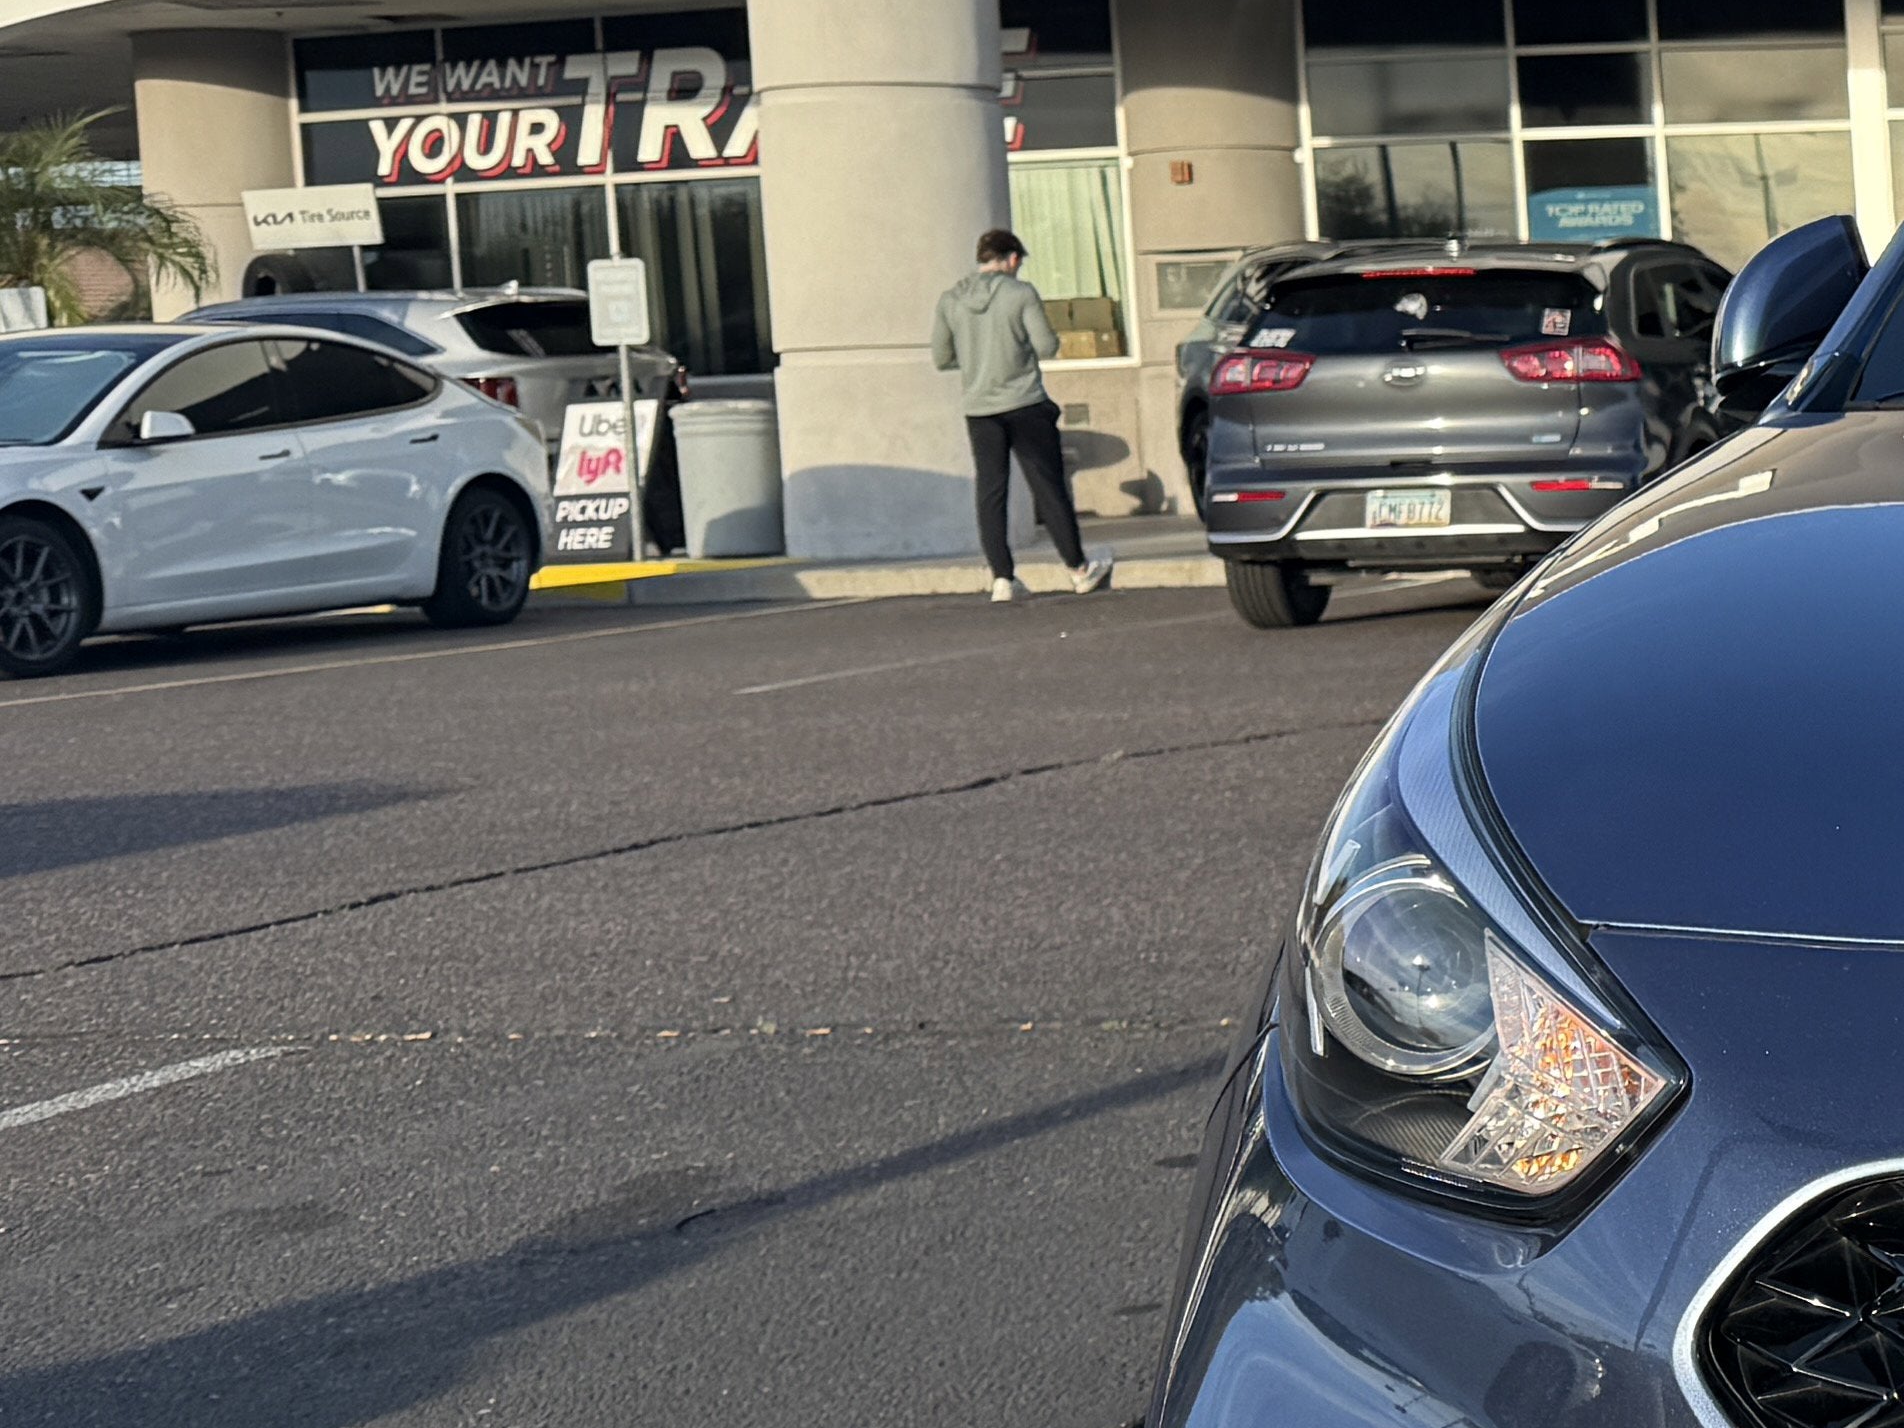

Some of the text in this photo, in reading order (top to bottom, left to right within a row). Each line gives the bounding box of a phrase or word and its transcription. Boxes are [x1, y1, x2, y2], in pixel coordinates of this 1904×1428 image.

[372, 54, 557, 98] WE WANT
[368, 108, 562, 178] YOUR
[299, 209, 324, 224] Tire
[325, 207, 371, 223] Source
[555, 496, 630, 523] PICKUP
[557, 526, 615, 552] HERE
